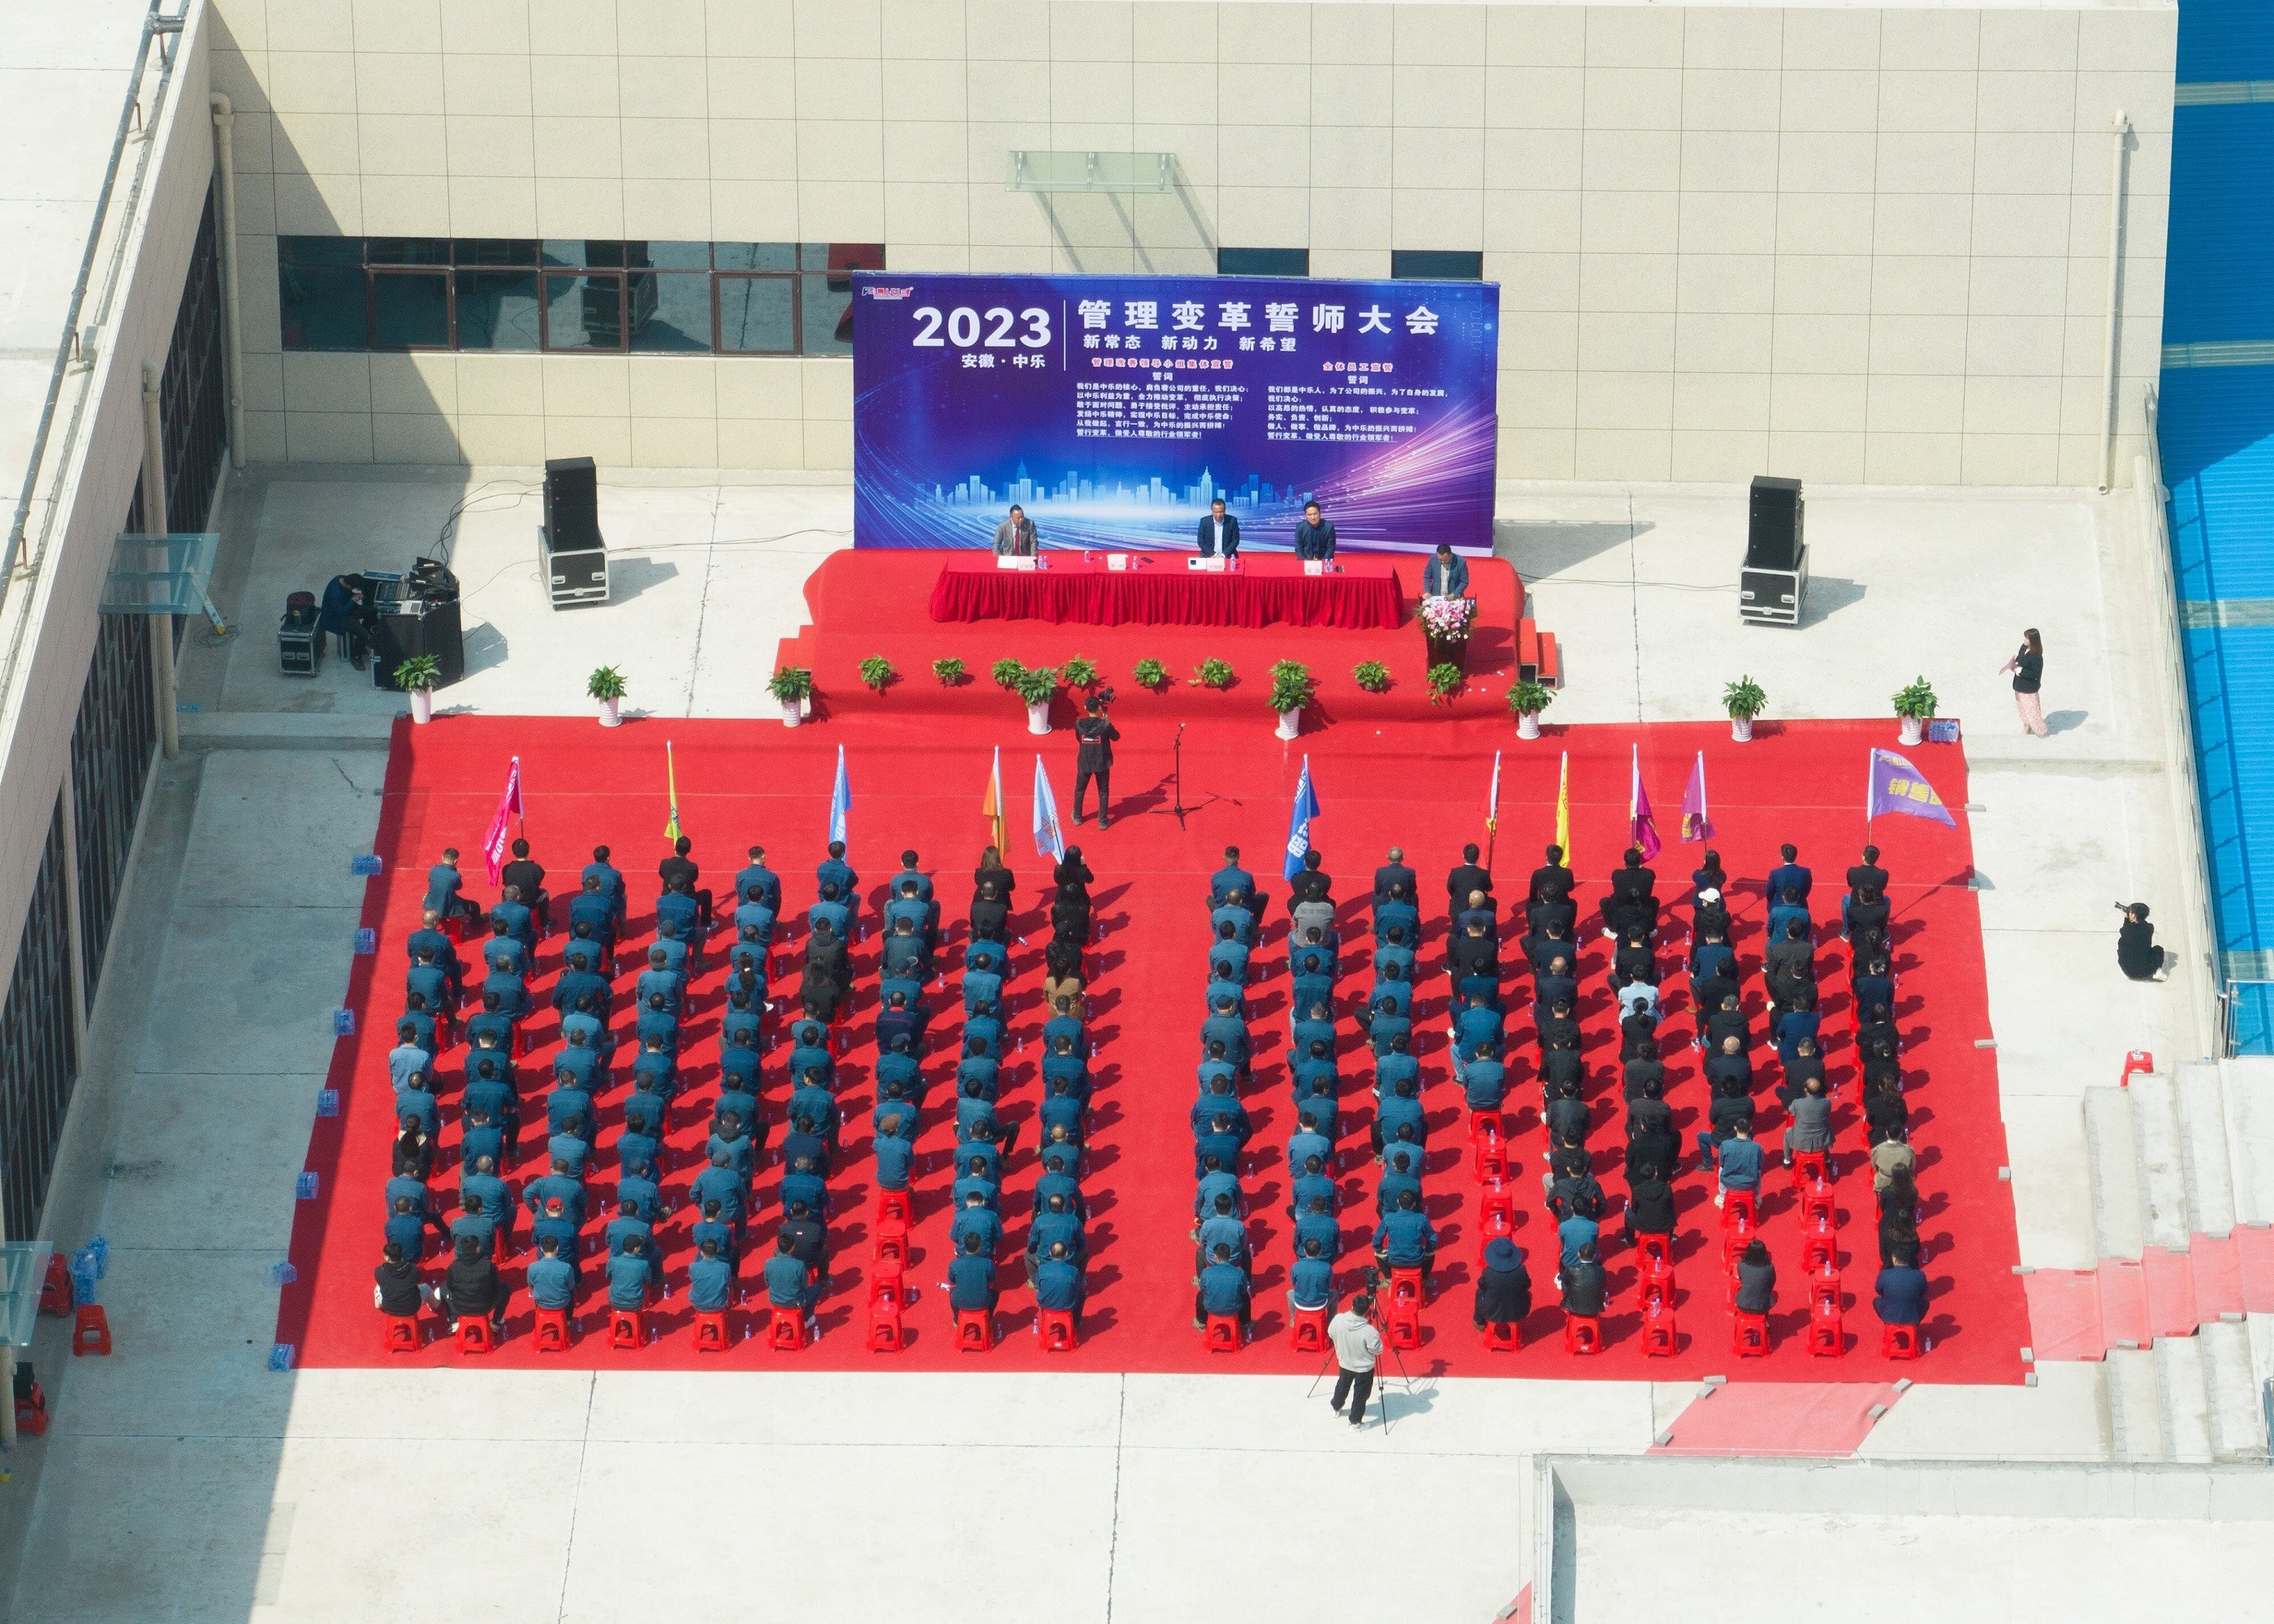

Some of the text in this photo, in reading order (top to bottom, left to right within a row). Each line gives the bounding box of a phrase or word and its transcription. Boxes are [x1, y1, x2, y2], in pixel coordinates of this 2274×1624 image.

[1077, 299, 1440, 335] 管理变革誓师大会
[912, 307, 1053, 348] 2023
[1083, 335, 1297, 352] 新常态 新动力 新希望
[1092, 357, 1234, 369] 管理改善领导小组集体宣誓
[1322, 361, 1393, 373] 全体员工宣誓
[1152, 371, 1174, 381] 誓词
[1347, 374, 1368, 384] 誓词
